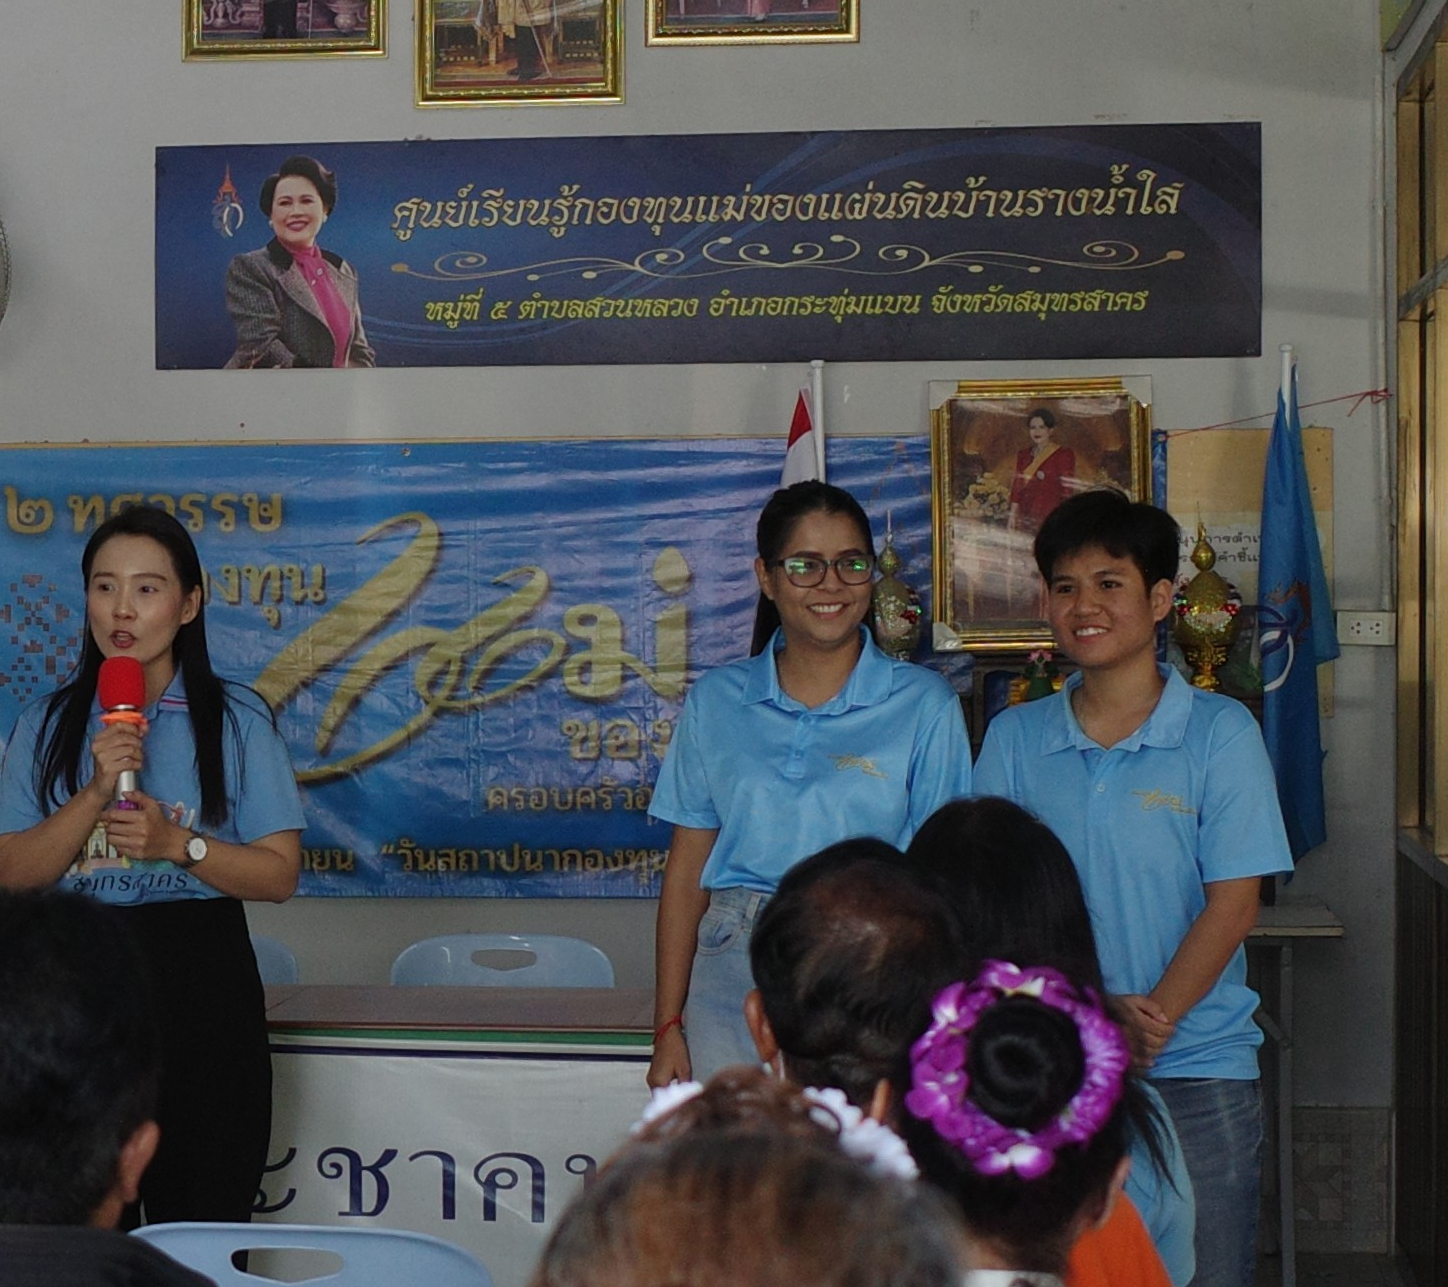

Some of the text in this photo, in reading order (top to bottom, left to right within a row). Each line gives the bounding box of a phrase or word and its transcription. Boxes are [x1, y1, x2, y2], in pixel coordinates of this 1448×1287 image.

[391, 163, 1186, 241] ศูนย์เรียนรู้กองทุนแม่ของแผ่นดินบ้านรางน้ำใส
[425, 284, 1150, 329] หมู่ที่ ๕ ตำบลสวนหลวง อำเภอกระทุ่มแบน จังหวัดสมุทรสาคร
[2, 485, 54, 535] ๒
[486, 775, 653, 811] ครอบครัวอ
[382, 838, 671, 885] “วันสถาปนากองทุน
